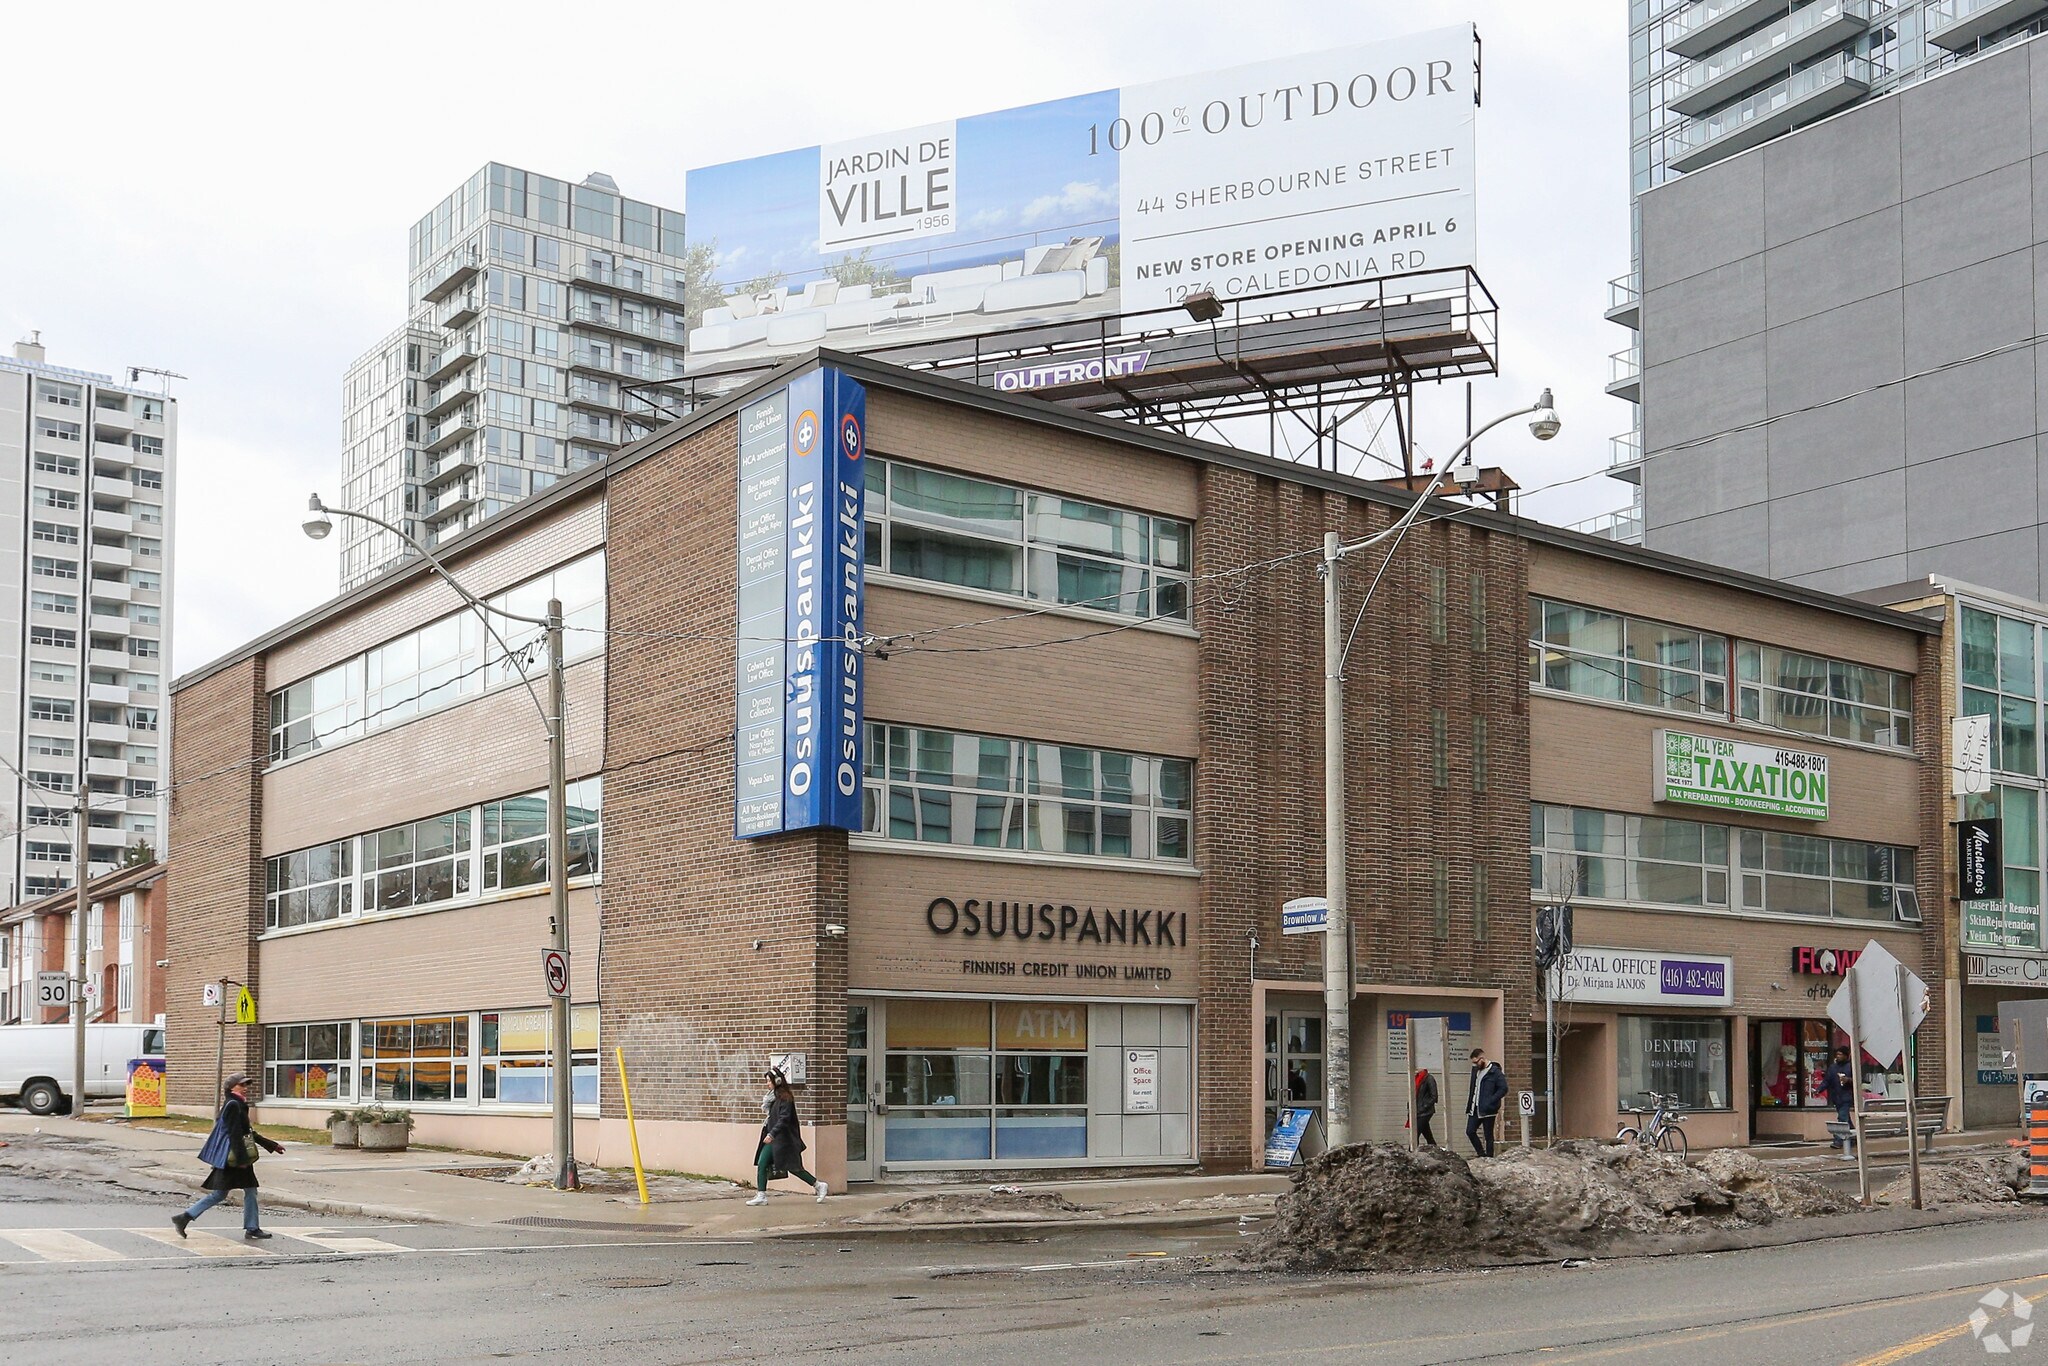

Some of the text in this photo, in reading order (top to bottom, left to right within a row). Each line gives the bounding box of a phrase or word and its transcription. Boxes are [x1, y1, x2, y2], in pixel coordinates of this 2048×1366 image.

[1088, 60, 1455, 156] 100% OUTDOOR
[826, 138, 950, 186] JARDIN DE
[1137, 147, 1455, 215] 44 SHERBOURNE STREET
[826, 168, 949, 227] VILLE
[916, 214, 950, 231] 1956
[1137, 218, 1457, 280] NEW STORE OPENING APRIL 6
[1226, 257, 1379, 296] CALEDONIA
[1392, 249, 1426, 272] RD
[1000, 355, 1142, 391] OUTFRONT
[748, 413, 782, 433] Credit Union
[743, 454, 756, 467] HCA
[760, 512, 775, 524] Office
[763, 547, 779, 560] Office
[790, 482, 818, 796] Osuuspankki
[837, 481, 861, 796] Osuuspankki
[759, 669, 774, 680] Office
[1694, 738, 1734, 757] ALL YEAR
[1775, 751, 1826, 772] 416-488-1801
[1667, 777, 1680, 785] SINCE
[1694, 756, 1826, 803] TAXATION
[1668, 789, 1826, 817] TAX PREPARATION BOOKKEEPING ACCOUNTING
[1969, 900, 1989, 911] Laser
[2009, 902, 2039, 915] Removal
[926, 897, 1187, 947] OSUUSPANKKI
[1283, 913, 1317, 926] Brownlow
[1969, 930, 1987, 941] Vein
[963, 960, 1172, 981] FINNISH CREDIT UNION LIMITED
[1612, 957, 1657, 975] OFFICE
[1985, 957, 2019, 977] Laser
[1583, 977, 1614, 990] Mirjana
[1616, 978, 1645, 990] JANJOS
[1662, 966, 1723, 989] (416) 482-0481
[41, 986, 65, 1001] 30
[1807, 984, 1835, 1001] of the
[1016, 1009, 1077, 1039] ATM
[1644, 1039, 1698, 1053] DENTIST
[1666, 1060, 1694, 1069] 482-0481
[1133, 1077, 1151, 1085] Space
